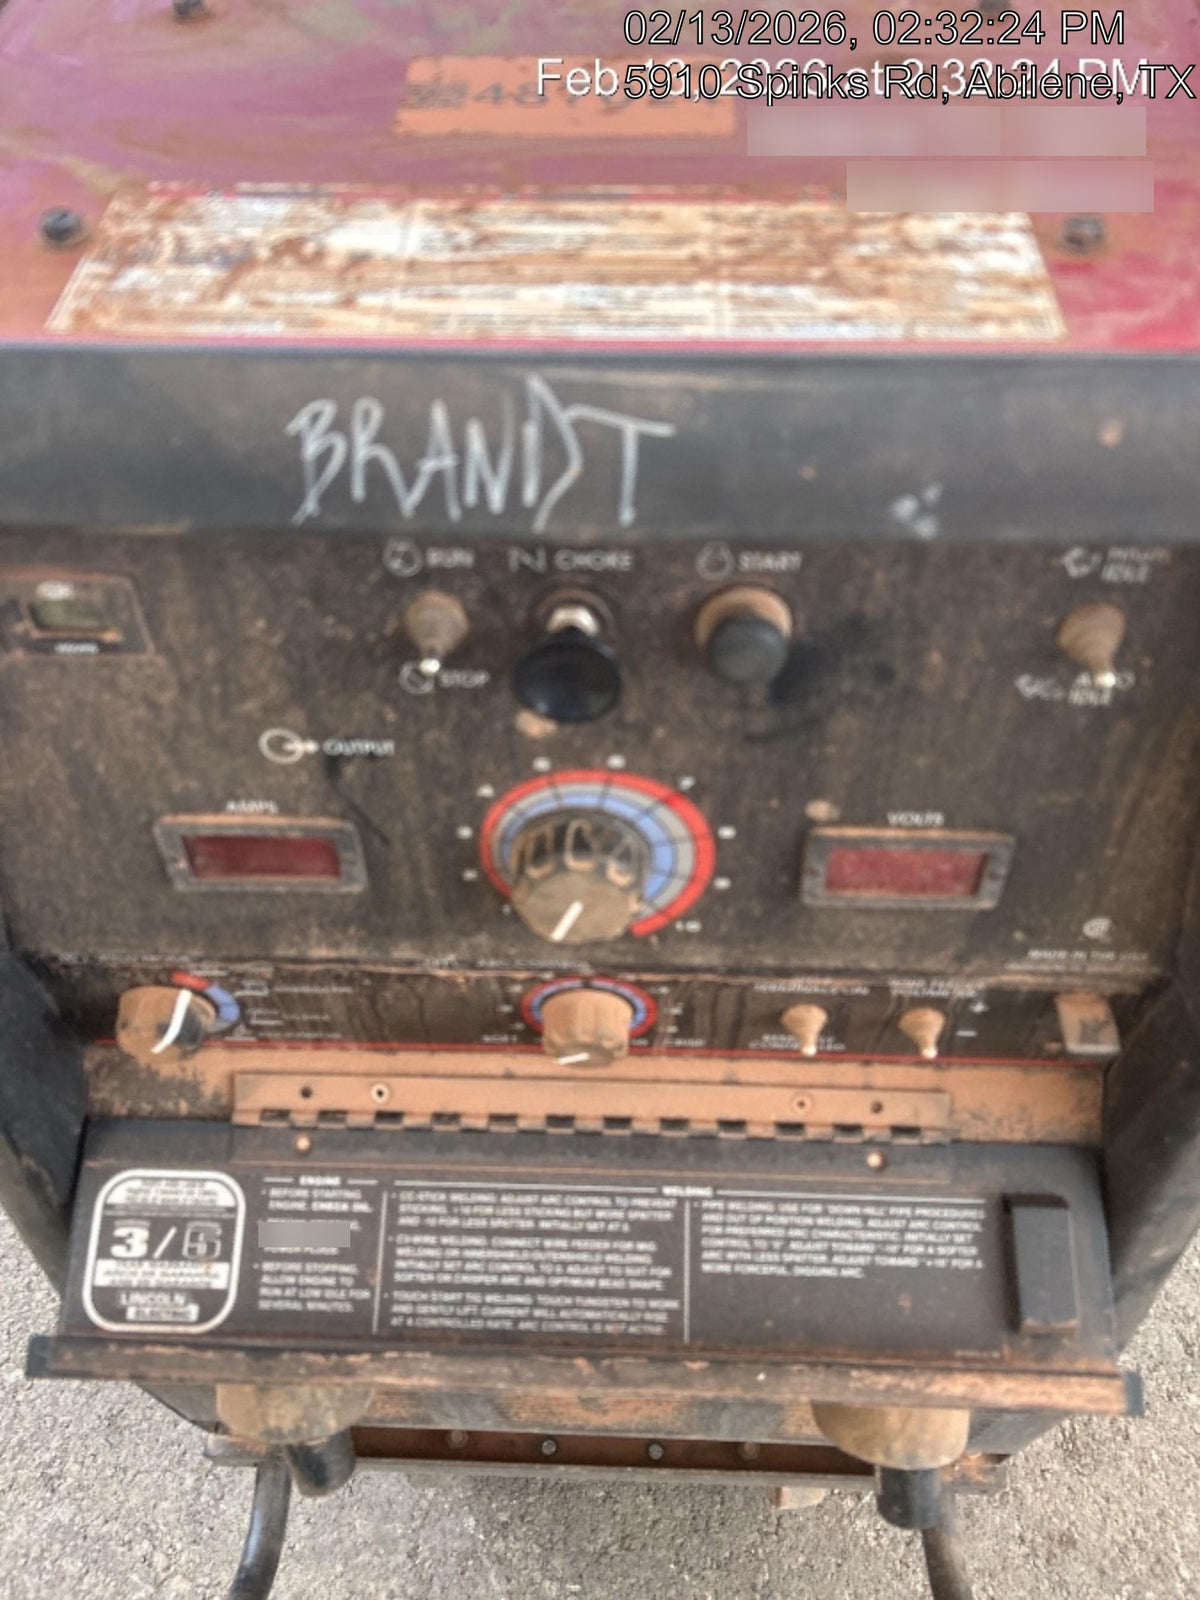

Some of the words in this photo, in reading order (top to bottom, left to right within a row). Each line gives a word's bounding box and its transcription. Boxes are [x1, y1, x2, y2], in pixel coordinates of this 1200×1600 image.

[285, 371, 677, 533] BRANDT
[426, 548, 475, 569] RUN
[554, 550, 635, 571] CHOKE
[737, 551, 803, 572] START
[439, 669, 491, 688] STOP
